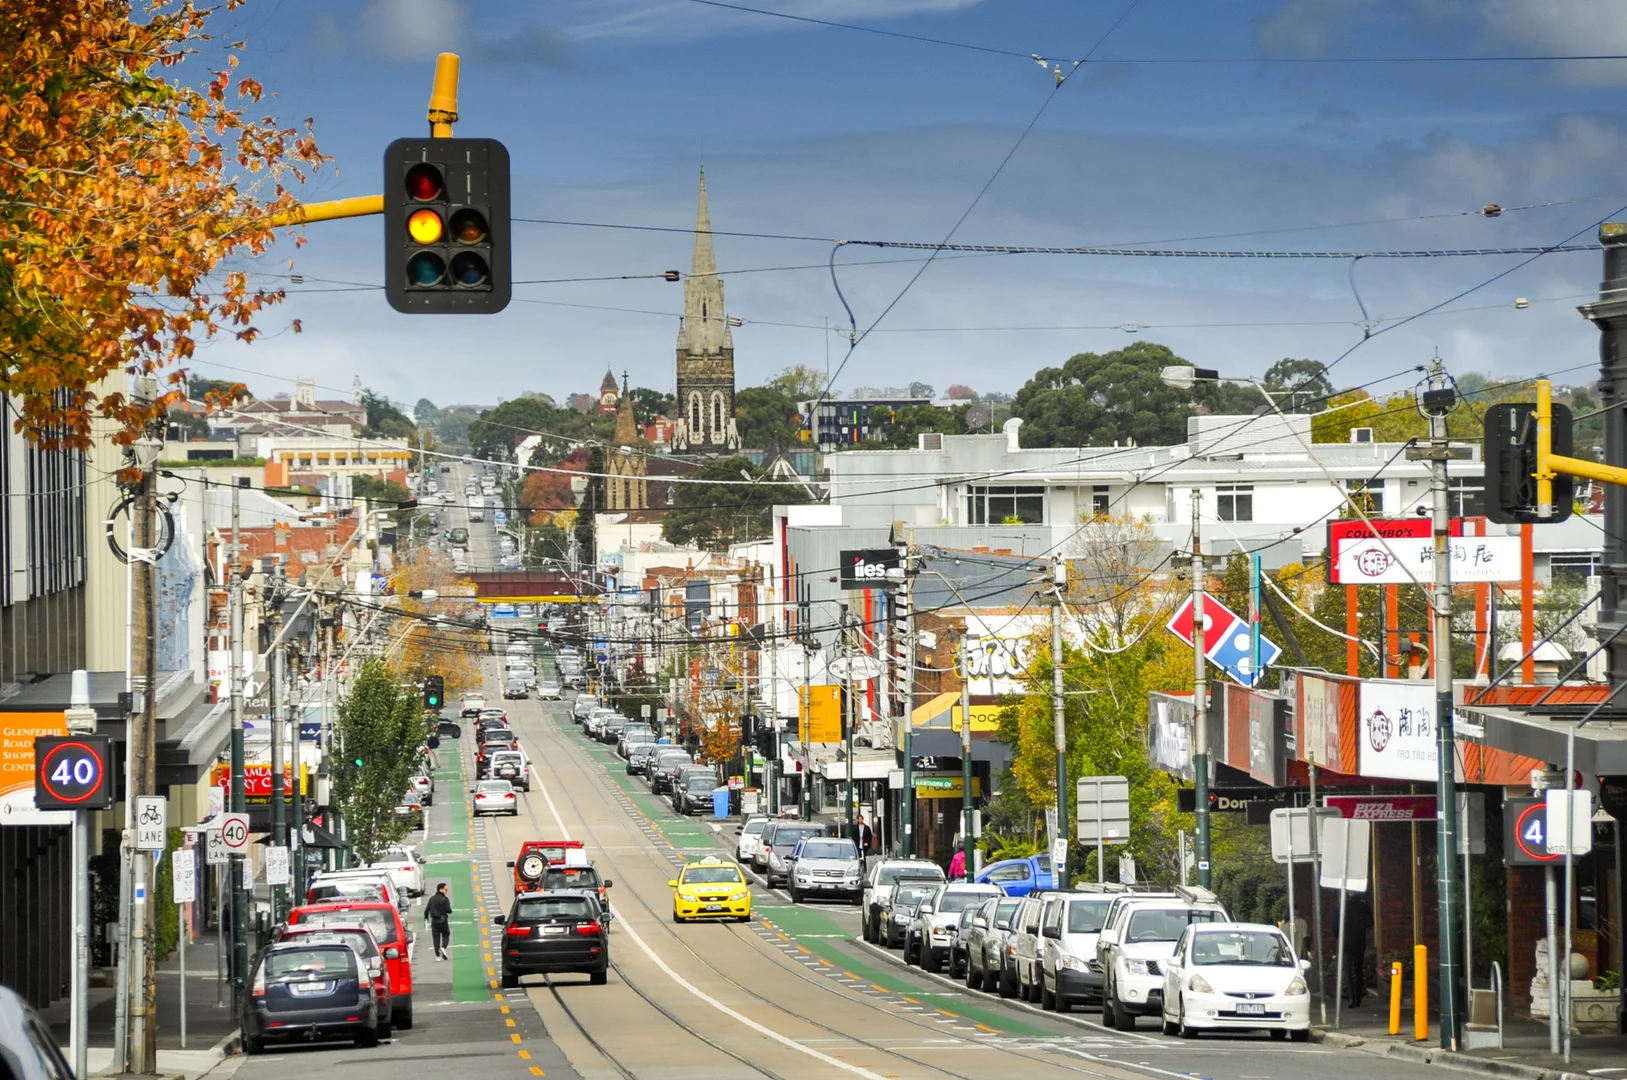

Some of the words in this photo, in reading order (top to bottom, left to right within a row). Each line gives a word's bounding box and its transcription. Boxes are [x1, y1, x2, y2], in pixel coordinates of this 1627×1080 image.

[1346, 529, 1413, 538] COLUMBO'S
[3, 727, 63, 736] GLENFERRIE
[3, 739, 31, 748] ROAD
[3, 751, 34, 759] SHOPP
[51, 758, 93, 785] 40
[1353, 809, 1414, 819] EXPRESS
[139, 831, 163, 843] LANE
[225, 826, 245, 840] 40
